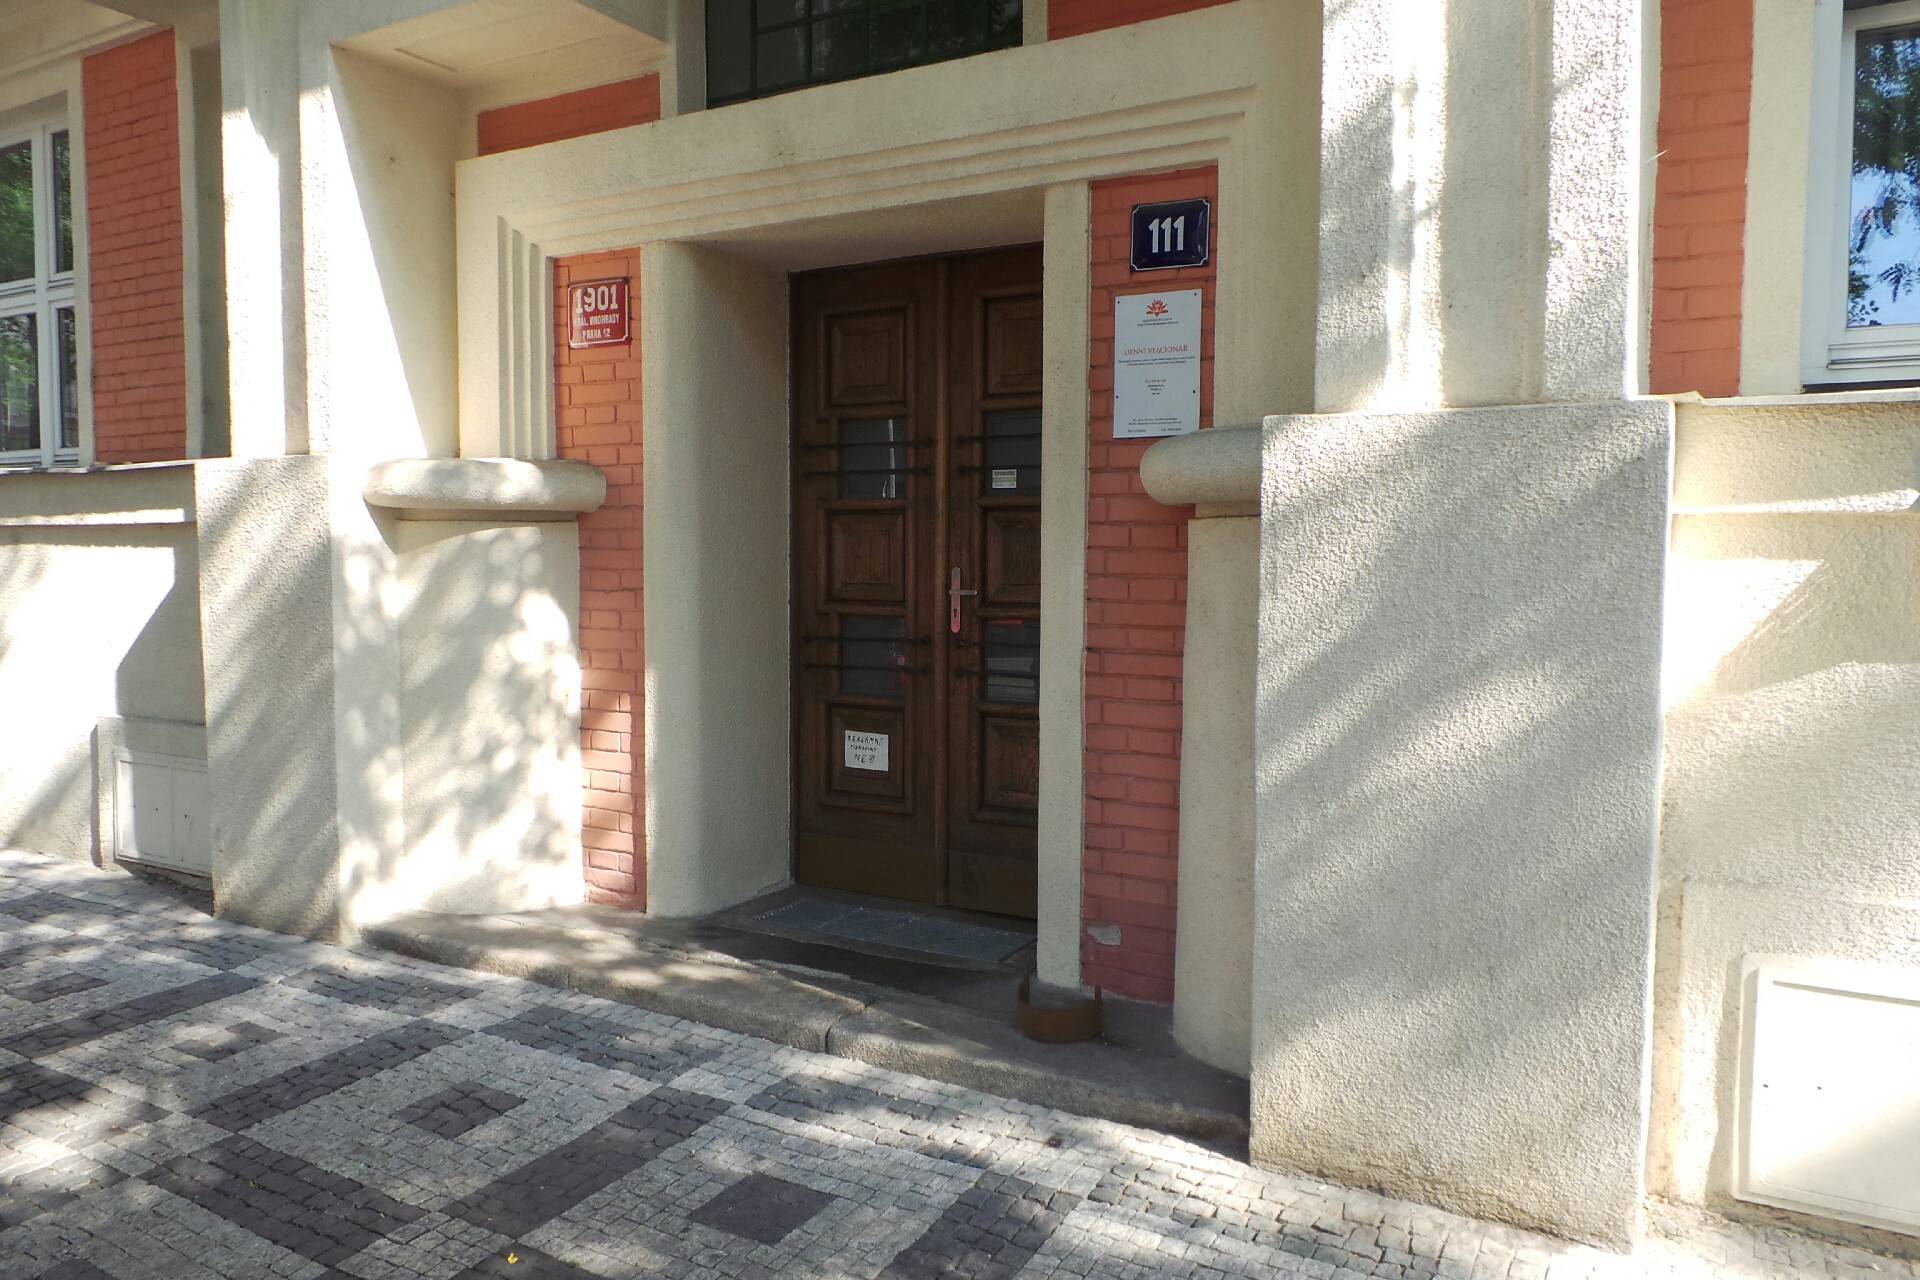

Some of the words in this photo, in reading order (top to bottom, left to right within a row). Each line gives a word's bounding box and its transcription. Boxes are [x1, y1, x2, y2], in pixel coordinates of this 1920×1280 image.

[1148, 216, 1184, 253] 111
[576, 285, 618, 314] 1901
[582, 329, 602, 340] PRAHA
[1124, 346, 1147, 356] DENNÍ
[854, 753, 867, 763] NE
